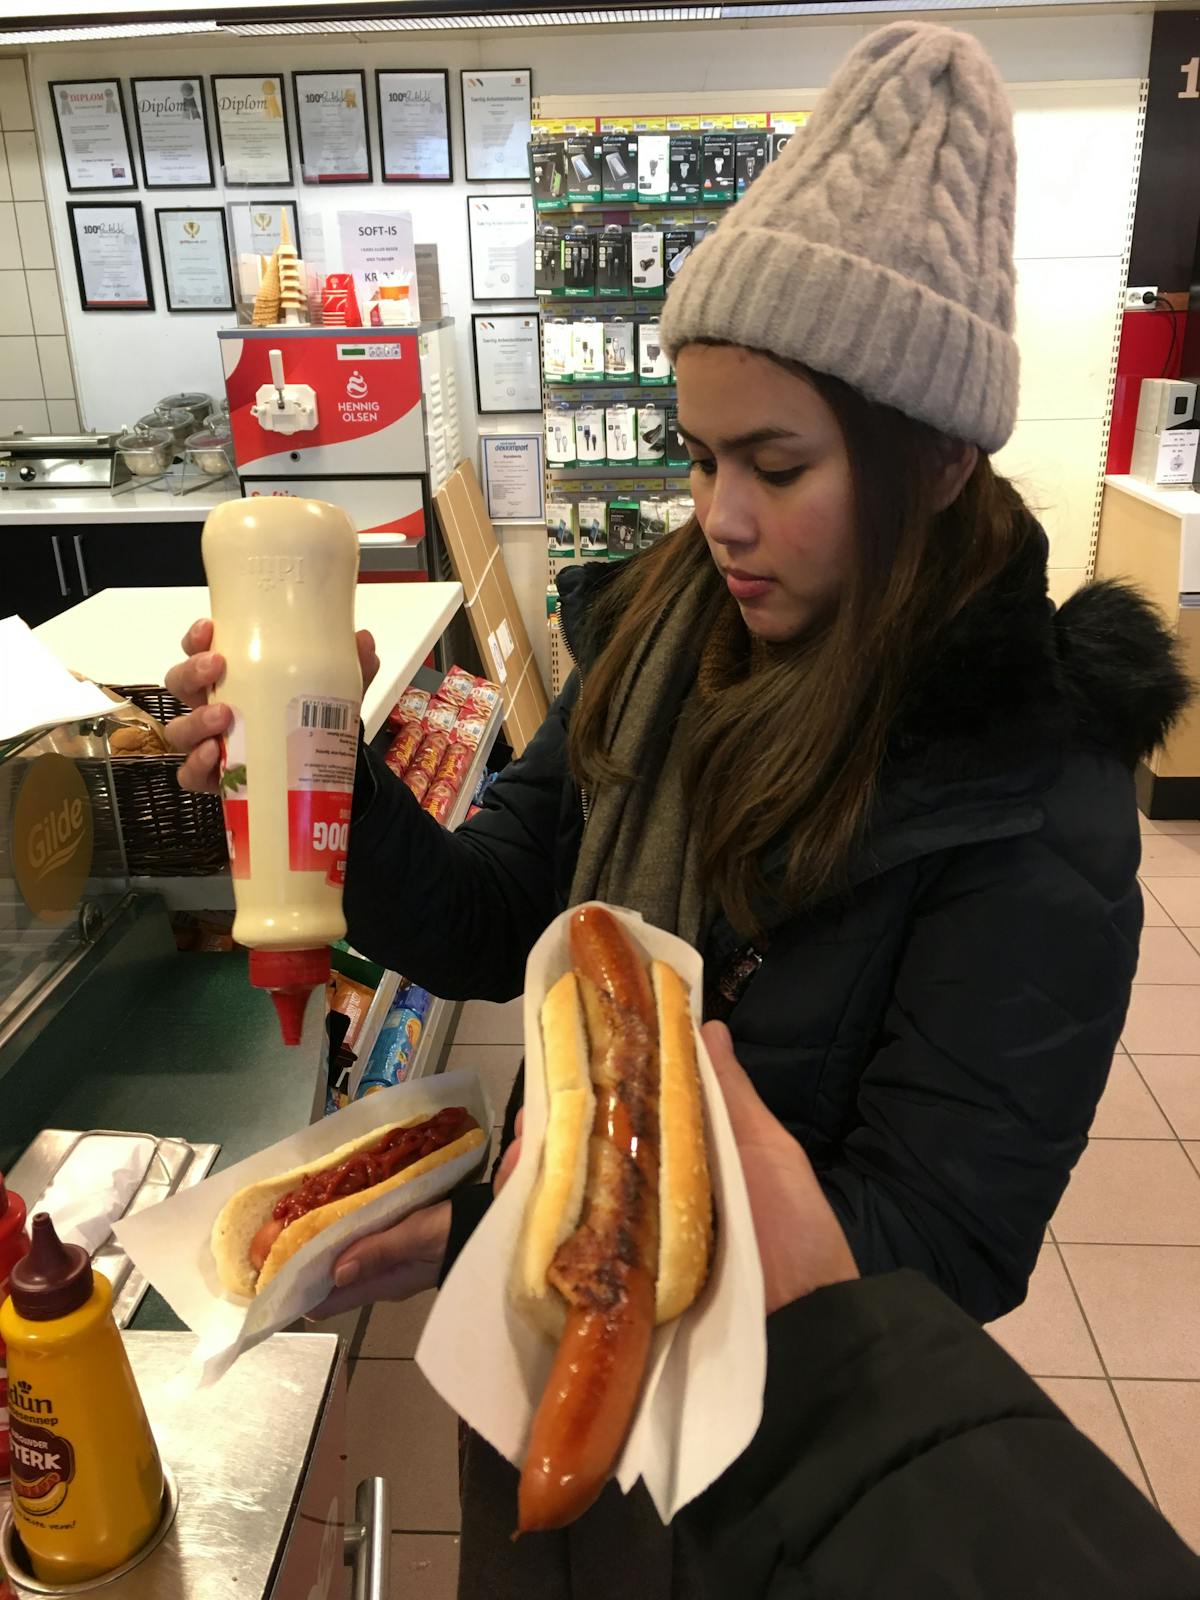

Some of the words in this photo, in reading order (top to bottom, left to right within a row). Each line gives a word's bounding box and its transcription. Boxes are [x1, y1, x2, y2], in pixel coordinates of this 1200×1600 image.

[70, 93, 104, 102] DIPLOM
[219, 94, 268, 115] Diplom
[141, 96, 187, 117] Diplom
[358, 226, 397, 236] SOFT-IS
[337, 401, 380, 411] HENNIG
[342, 412, 377, 422] OLSEN
[28, 798, 83, 868] Gilde
[9, 1383, 53, 1413] dun
